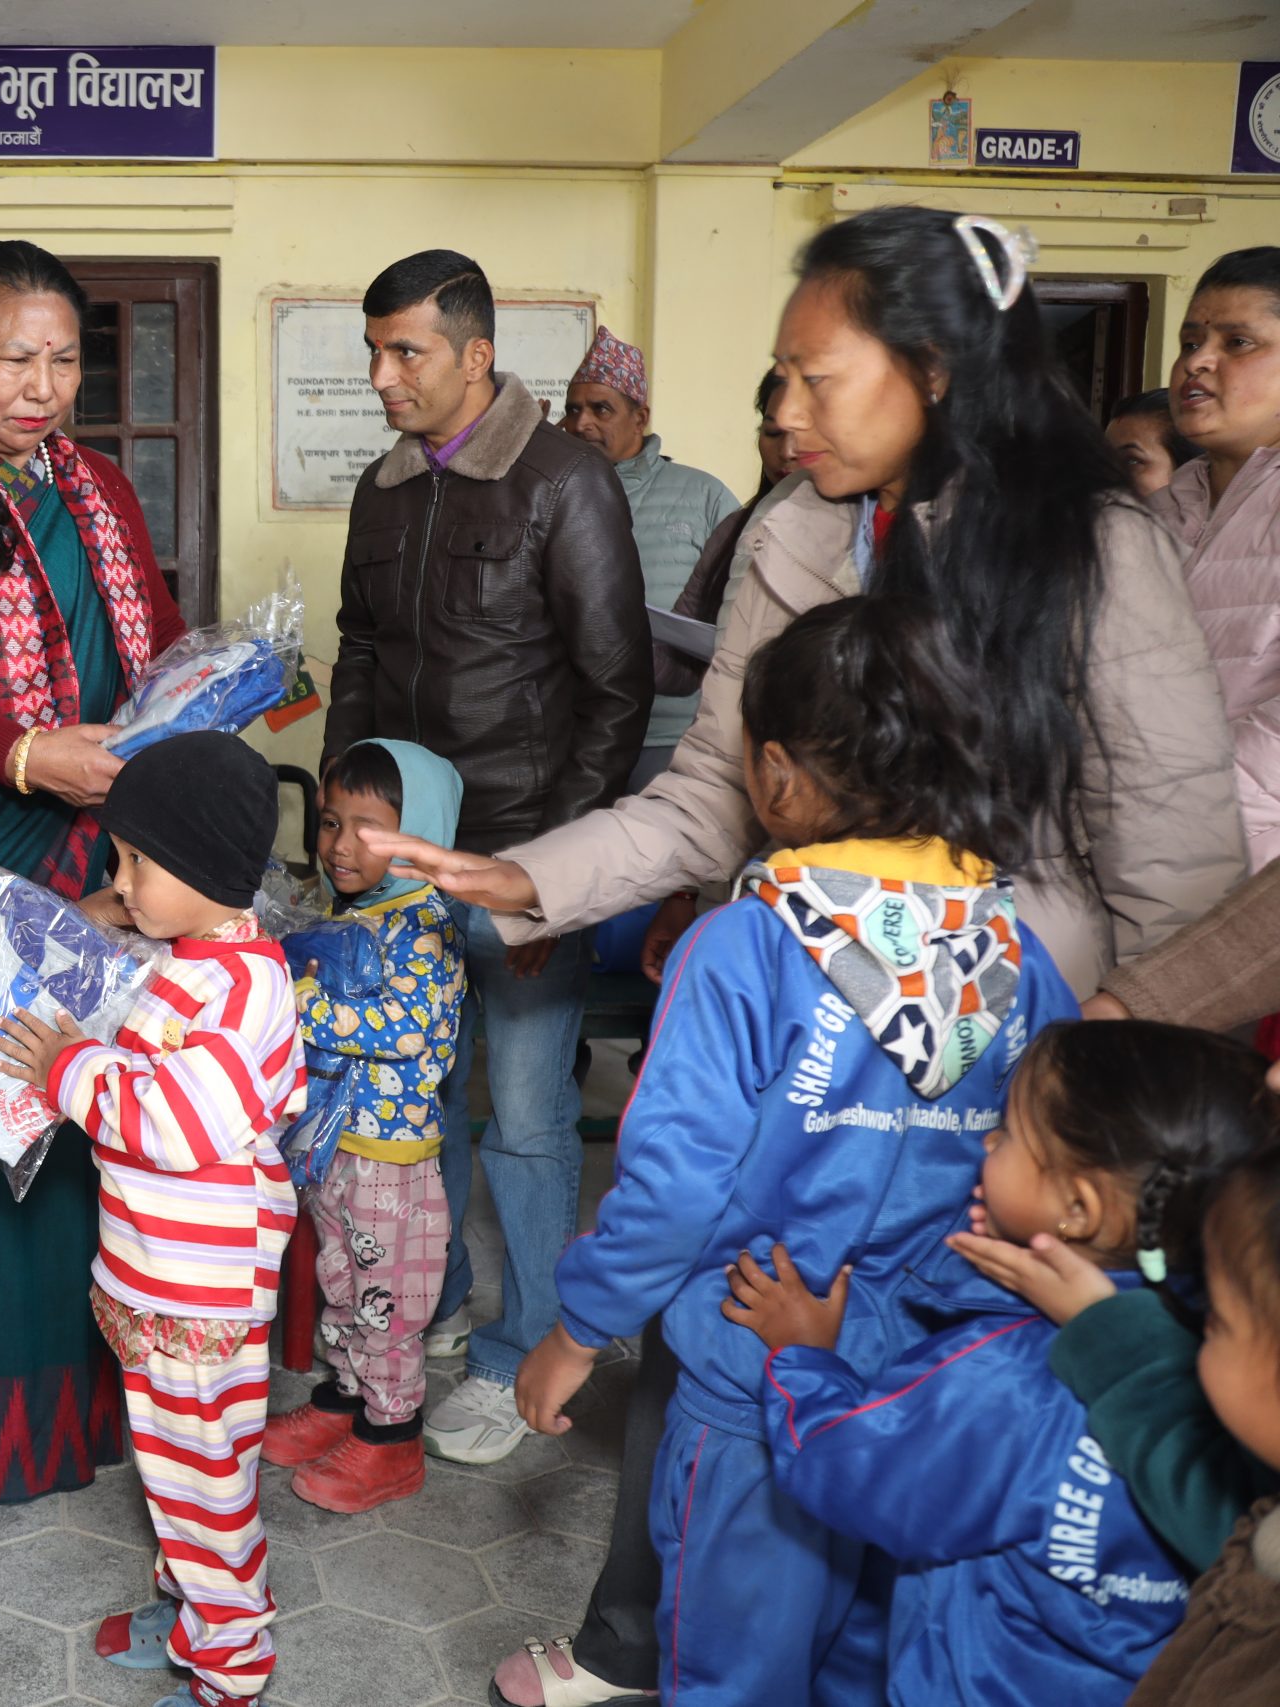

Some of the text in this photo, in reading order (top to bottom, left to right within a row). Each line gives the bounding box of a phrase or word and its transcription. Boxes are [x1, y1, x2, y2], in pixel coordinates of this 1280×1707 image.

[68, 52, 205, 110] विद्यालय
[981, 136, 1075, 161] GRADE-1
[287, 377, 372, 386] FOUNDATION STON
[298, 388, 325, 397] GRAM
[327, 388, 363, 397] SUDHAR
[361, 409, 386, 417] SHAN
[786, 991, 856, 1107] SHREE GR
[956, 1016, 978, 1077] CONVE
[375, 1191, 440, 1232] SNOOPY
[1047, 1435, 1113, 1583] SHREE GR
